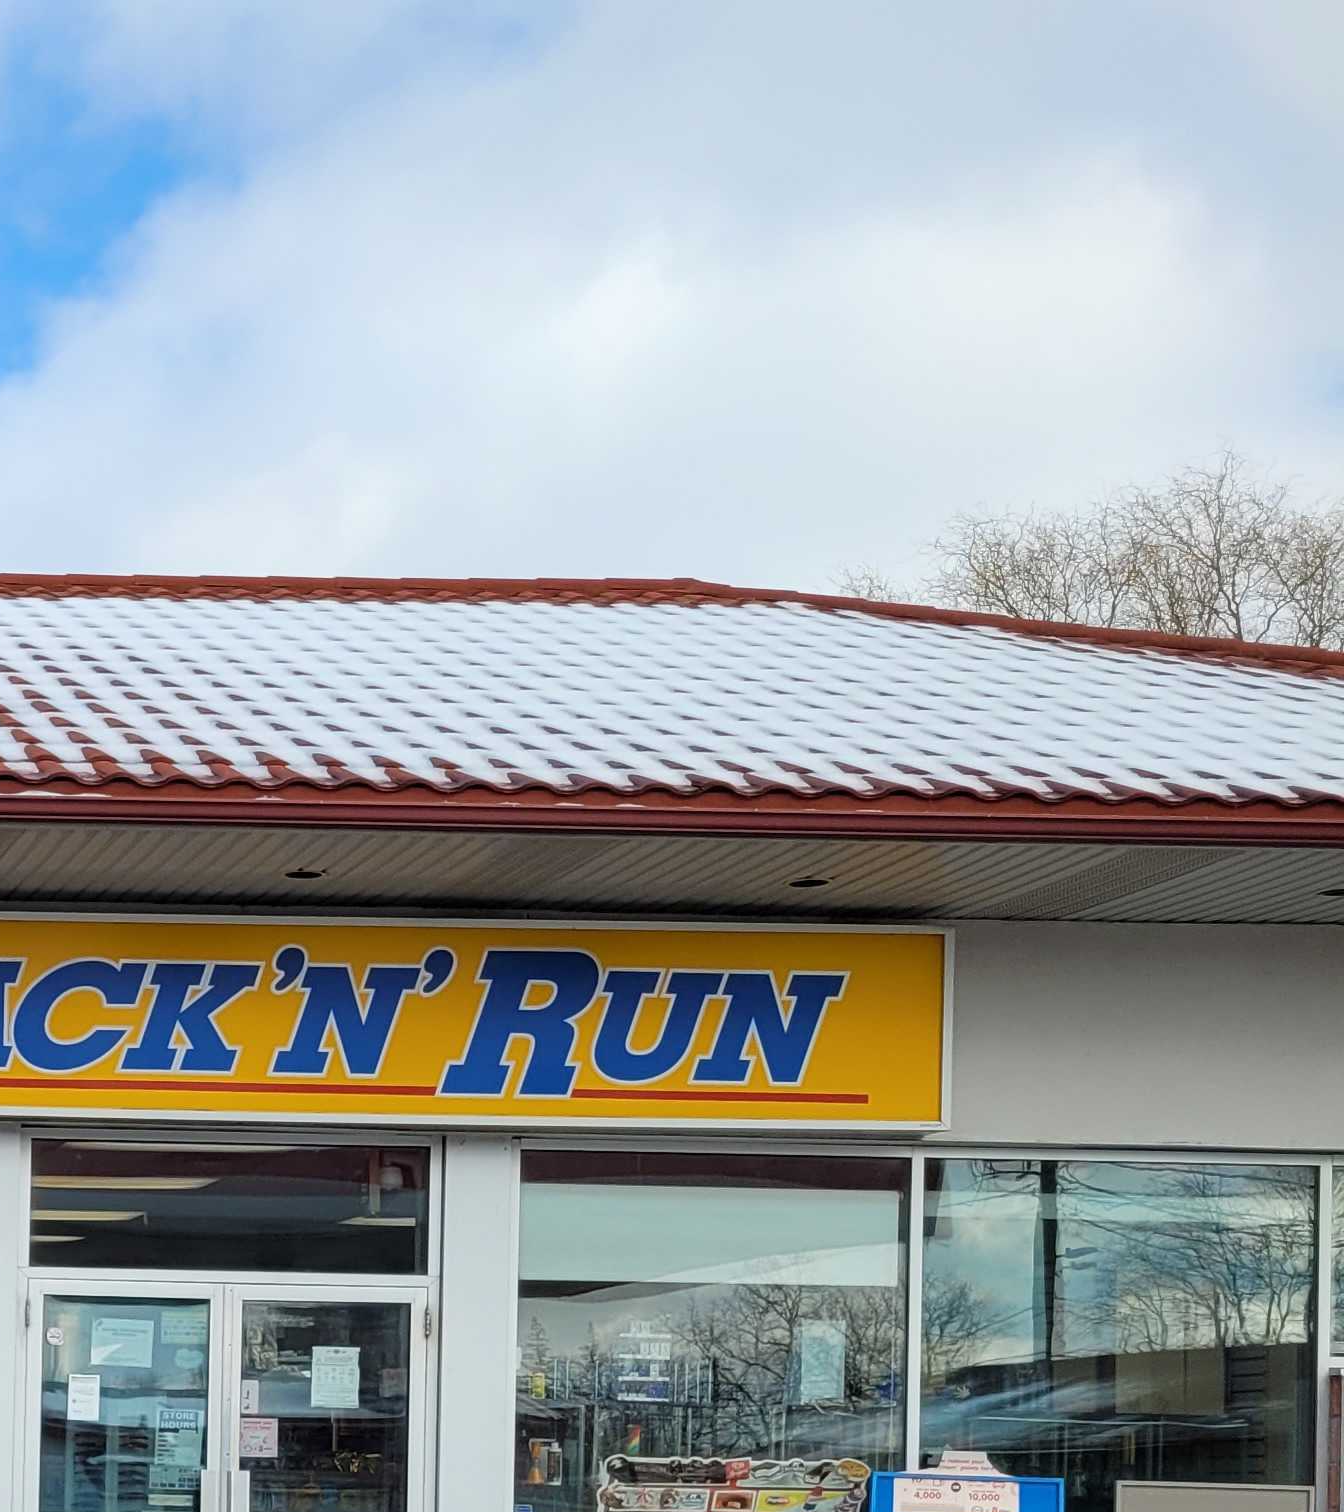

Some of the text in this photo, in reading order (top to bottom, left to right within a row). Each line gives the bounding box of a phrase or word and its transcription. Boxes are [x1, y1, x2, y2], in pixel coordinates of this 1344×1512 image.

[162, 1412, 196, 1420] STORE
[160, 1421, 196, 1429] HOURS
[969, 1493, 1000, 1501] 10,000
